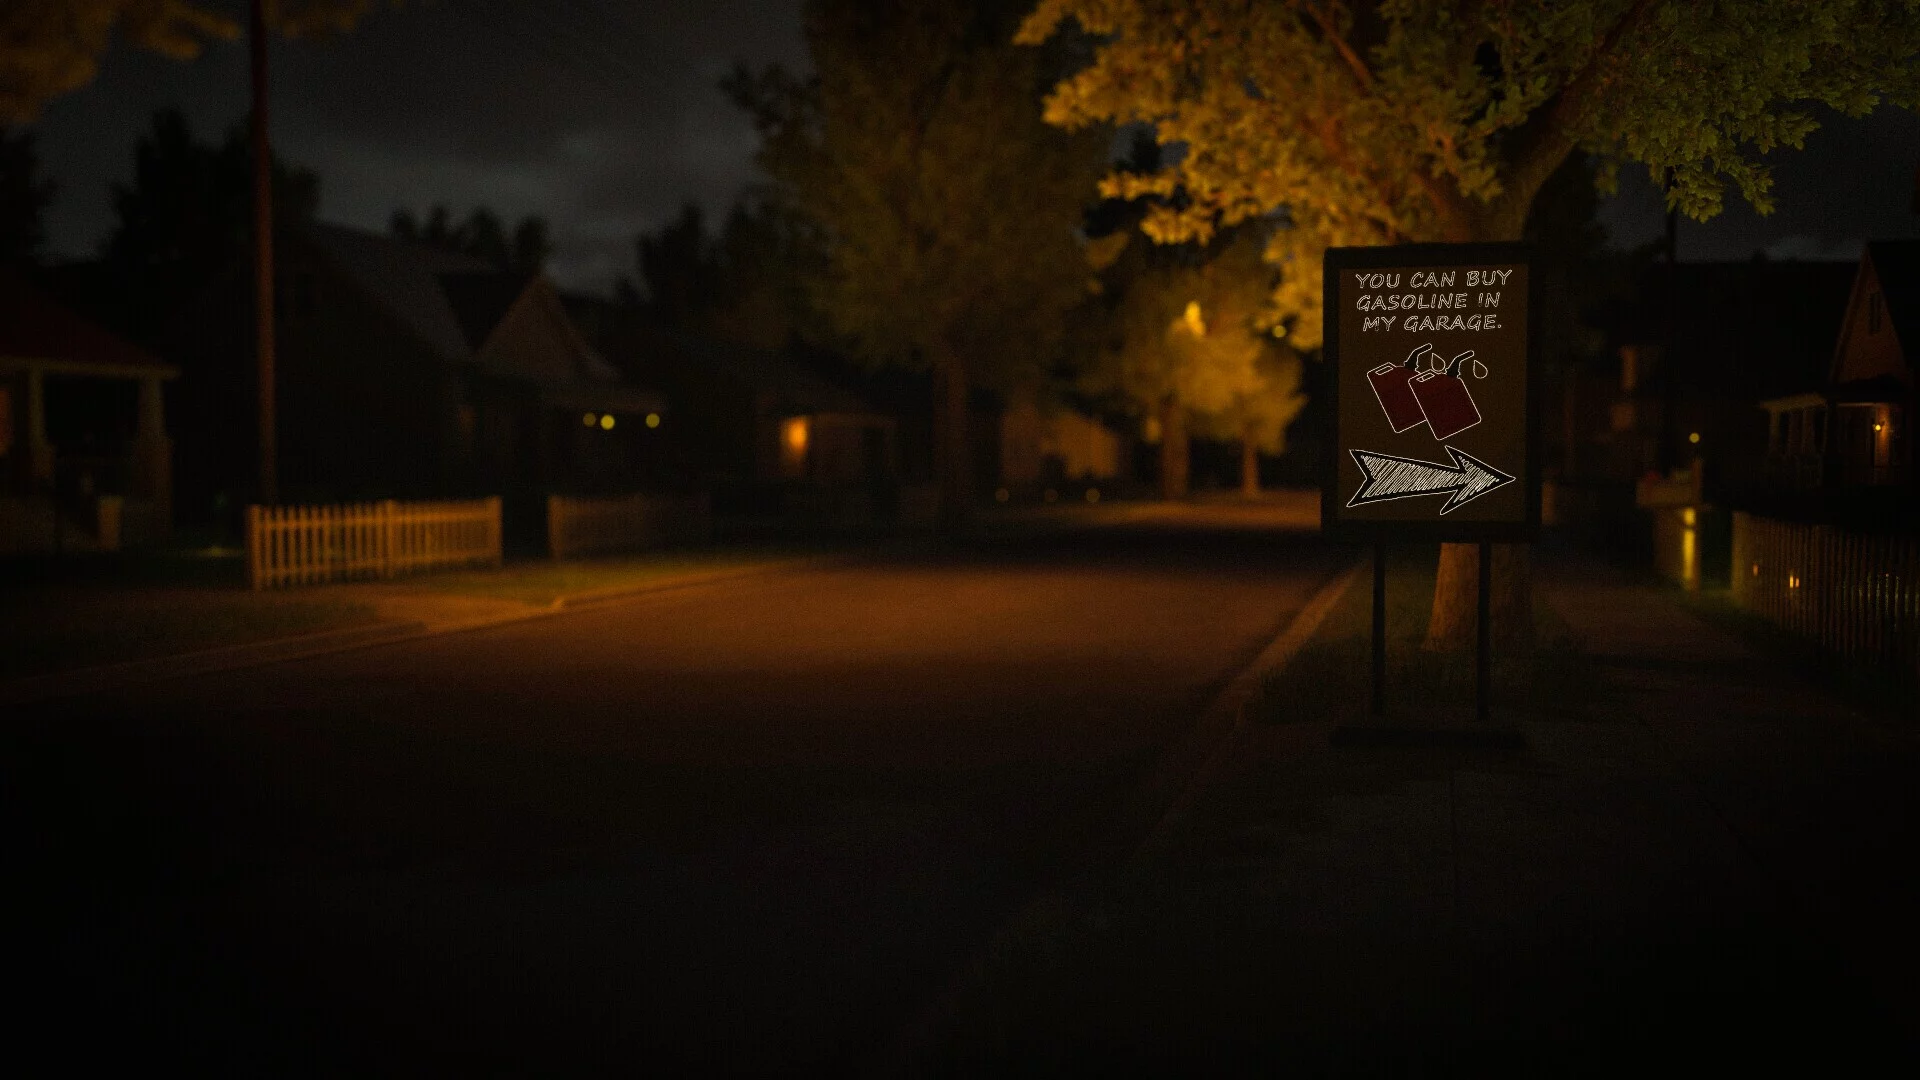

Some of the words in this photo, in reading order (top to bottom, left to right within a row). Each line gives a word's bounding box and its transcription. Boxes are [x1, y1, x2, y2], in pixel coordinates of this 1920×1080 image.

[1355, 273, 1400, 289] YOU
[1410, 271, 1456, 288] CAN
[1466, 269, 1513, 287] BUY
[1356, 292, 1468, 312] GASOLINE
[1478, 292, 1501, 308] IN
[1362, 316, 1396, 332] MY
[1403, 314, 1502, 333] GARAGE.
